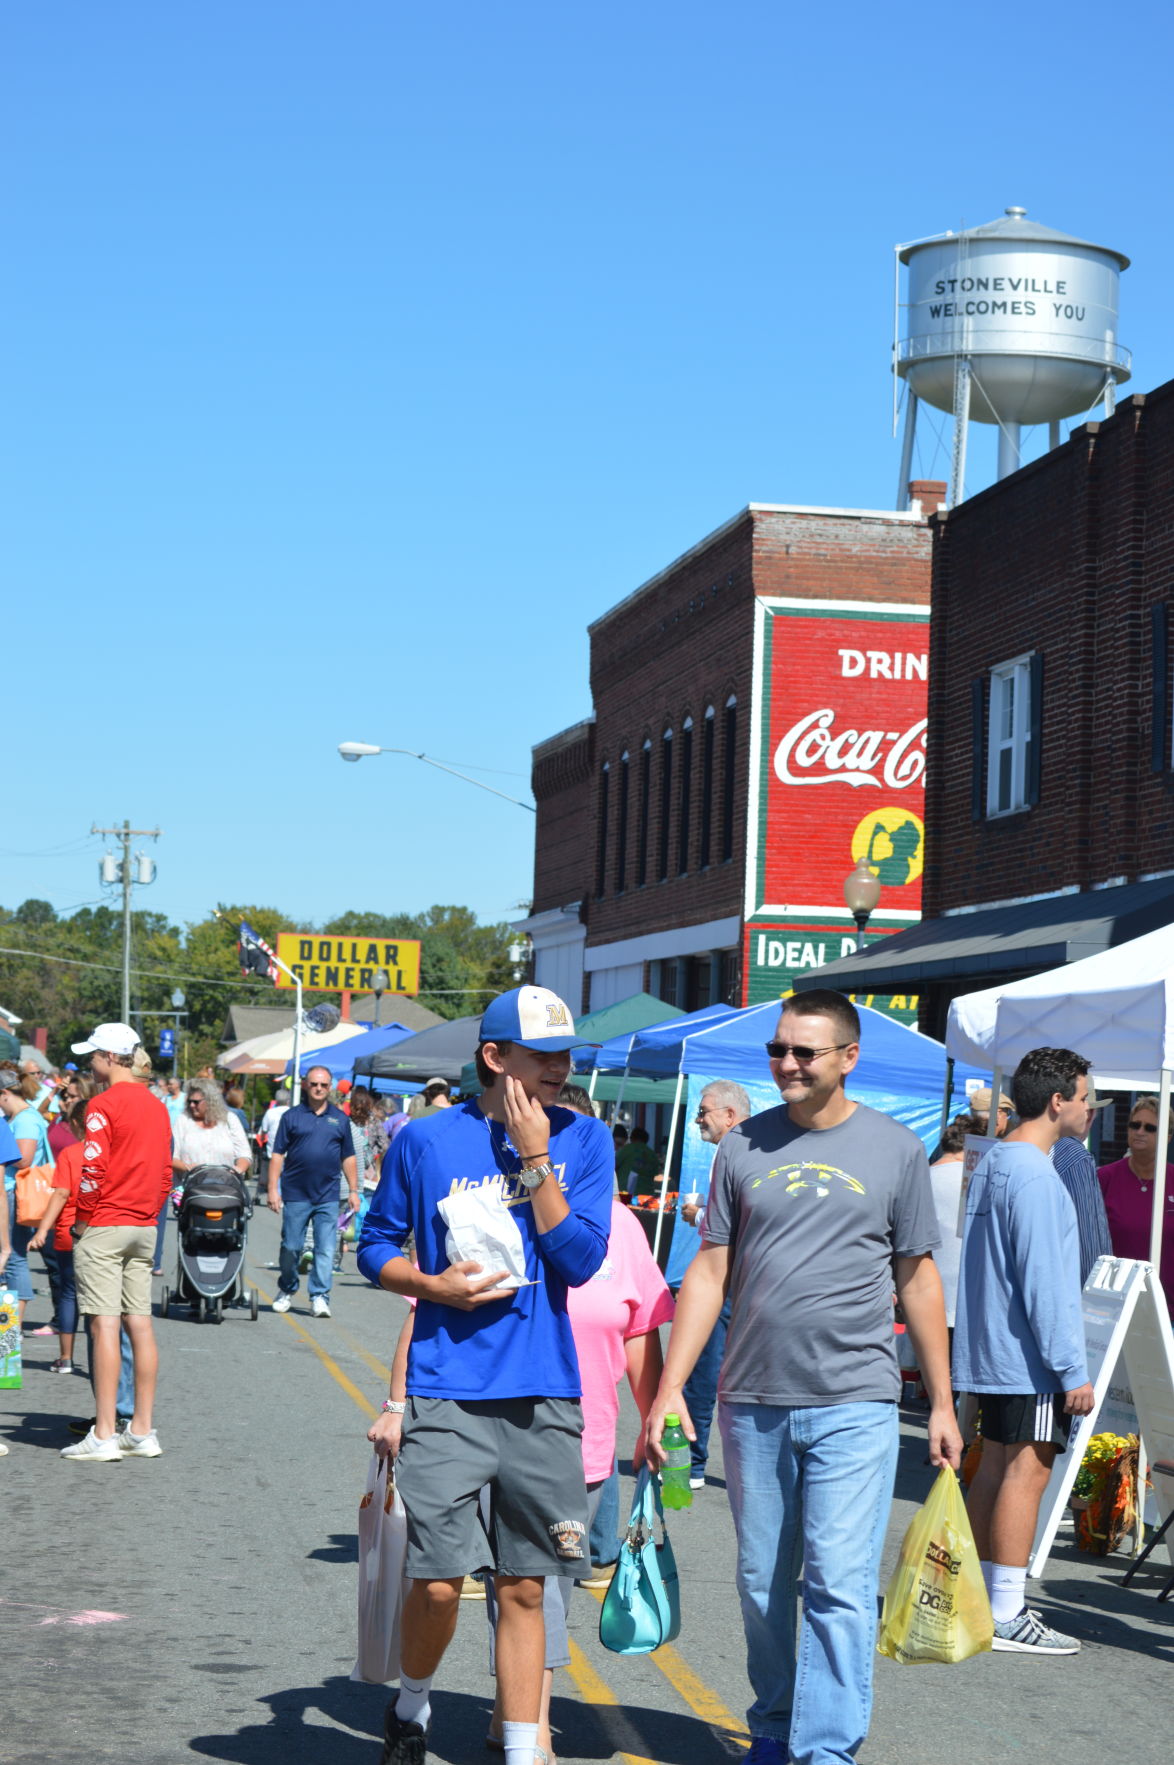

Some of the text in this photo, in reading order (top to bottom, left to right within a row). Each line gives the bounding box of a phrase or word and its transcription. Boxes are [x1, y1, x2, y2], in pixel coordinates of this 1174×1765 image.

[935, 277, 1067, 296] STONEVILLE
[929, 300, 1086, 321] WELCOMES YOU
[838, 649, 929, 681] DRIN
[774, 708, 929, 789] Coca-C
[299, 940, 399, 966] DOLLAR
[757, 934, 827, 968] IDEAL
[291, 964, 406, 991] GENERAL
[546, 1004, 568, 1027] M
[919, 1589, 941, 1610] DG
